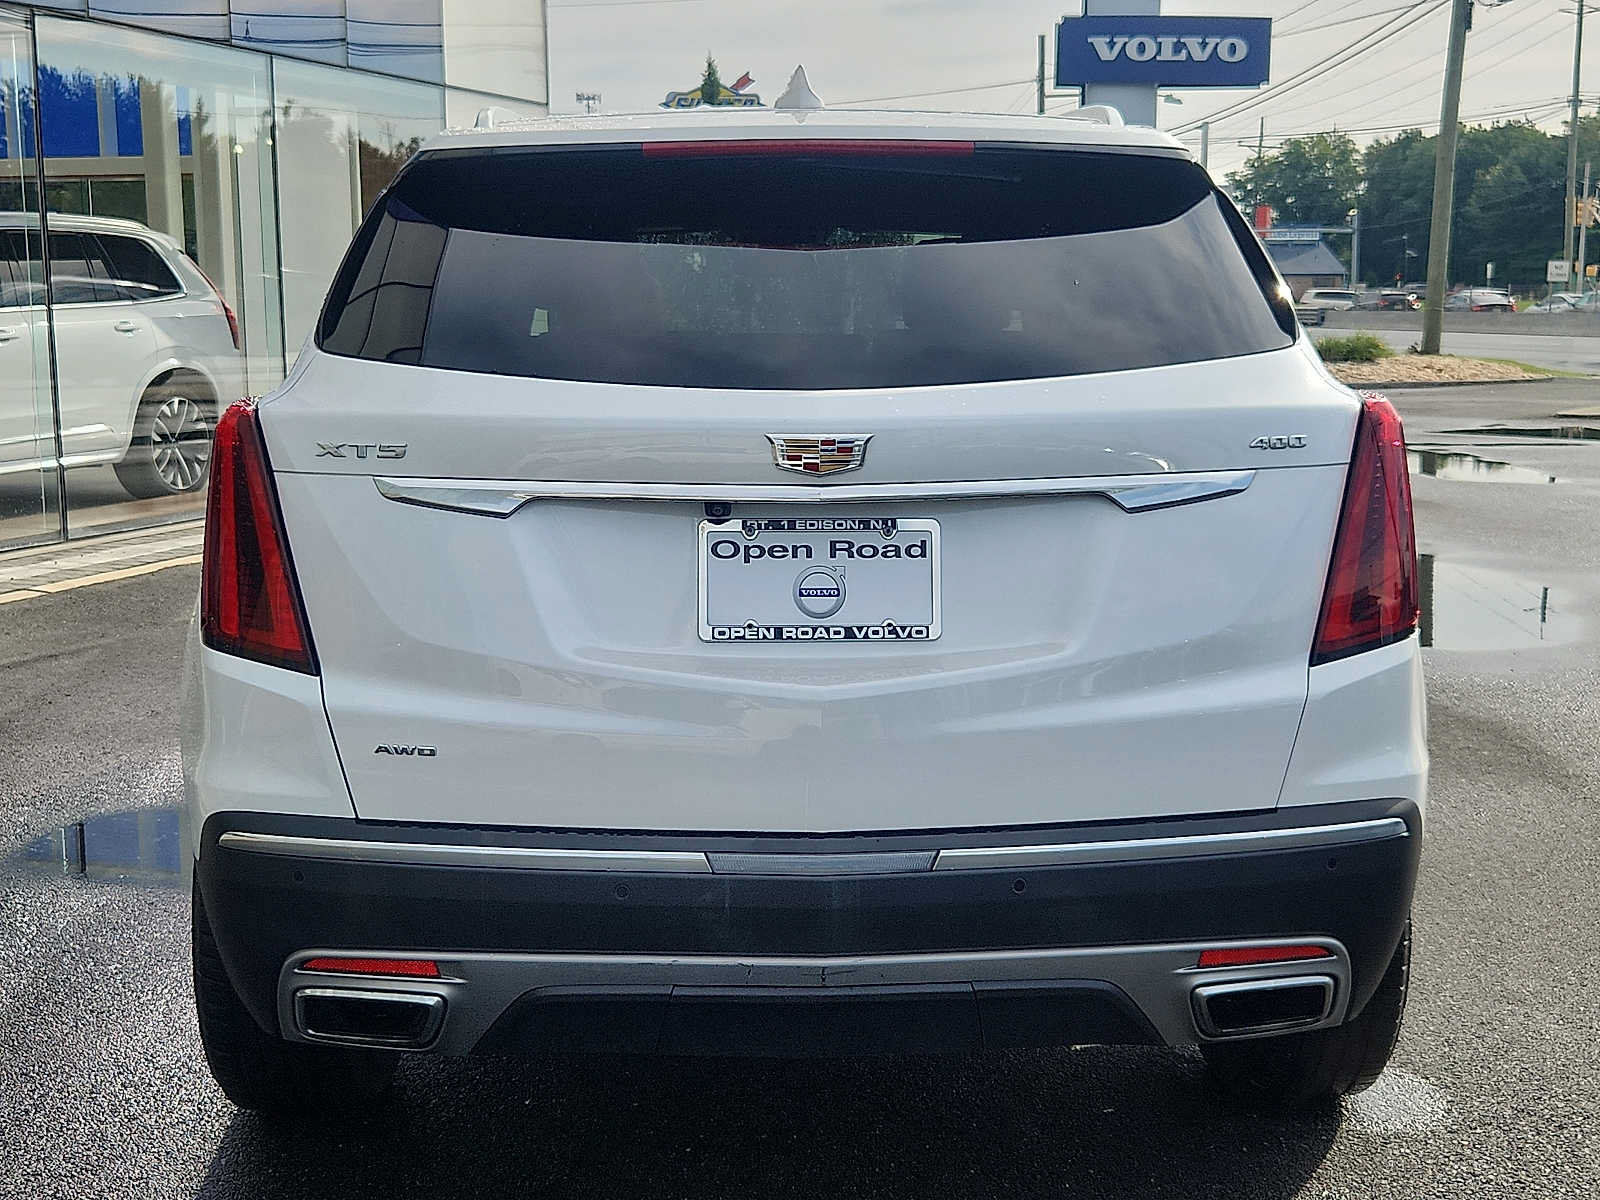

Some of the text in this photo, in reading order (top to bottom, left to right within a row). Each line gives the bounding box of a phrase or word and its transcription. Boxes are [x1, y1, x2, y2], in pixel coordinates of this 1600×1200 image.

[1087, 36, 1248, 62] VOLVO
[315, 441, 408, 459] XT5
[1249, 434, 1308, 450] 400
[781, 520, 789, 530] 1
[795, 520, 864, 531] EDISON,
[710, 539, 927, 564] Open Road
[713, 626, 928, 640] OPEN ROAD VOLVO
[374, 744, 437, 757] AWD
